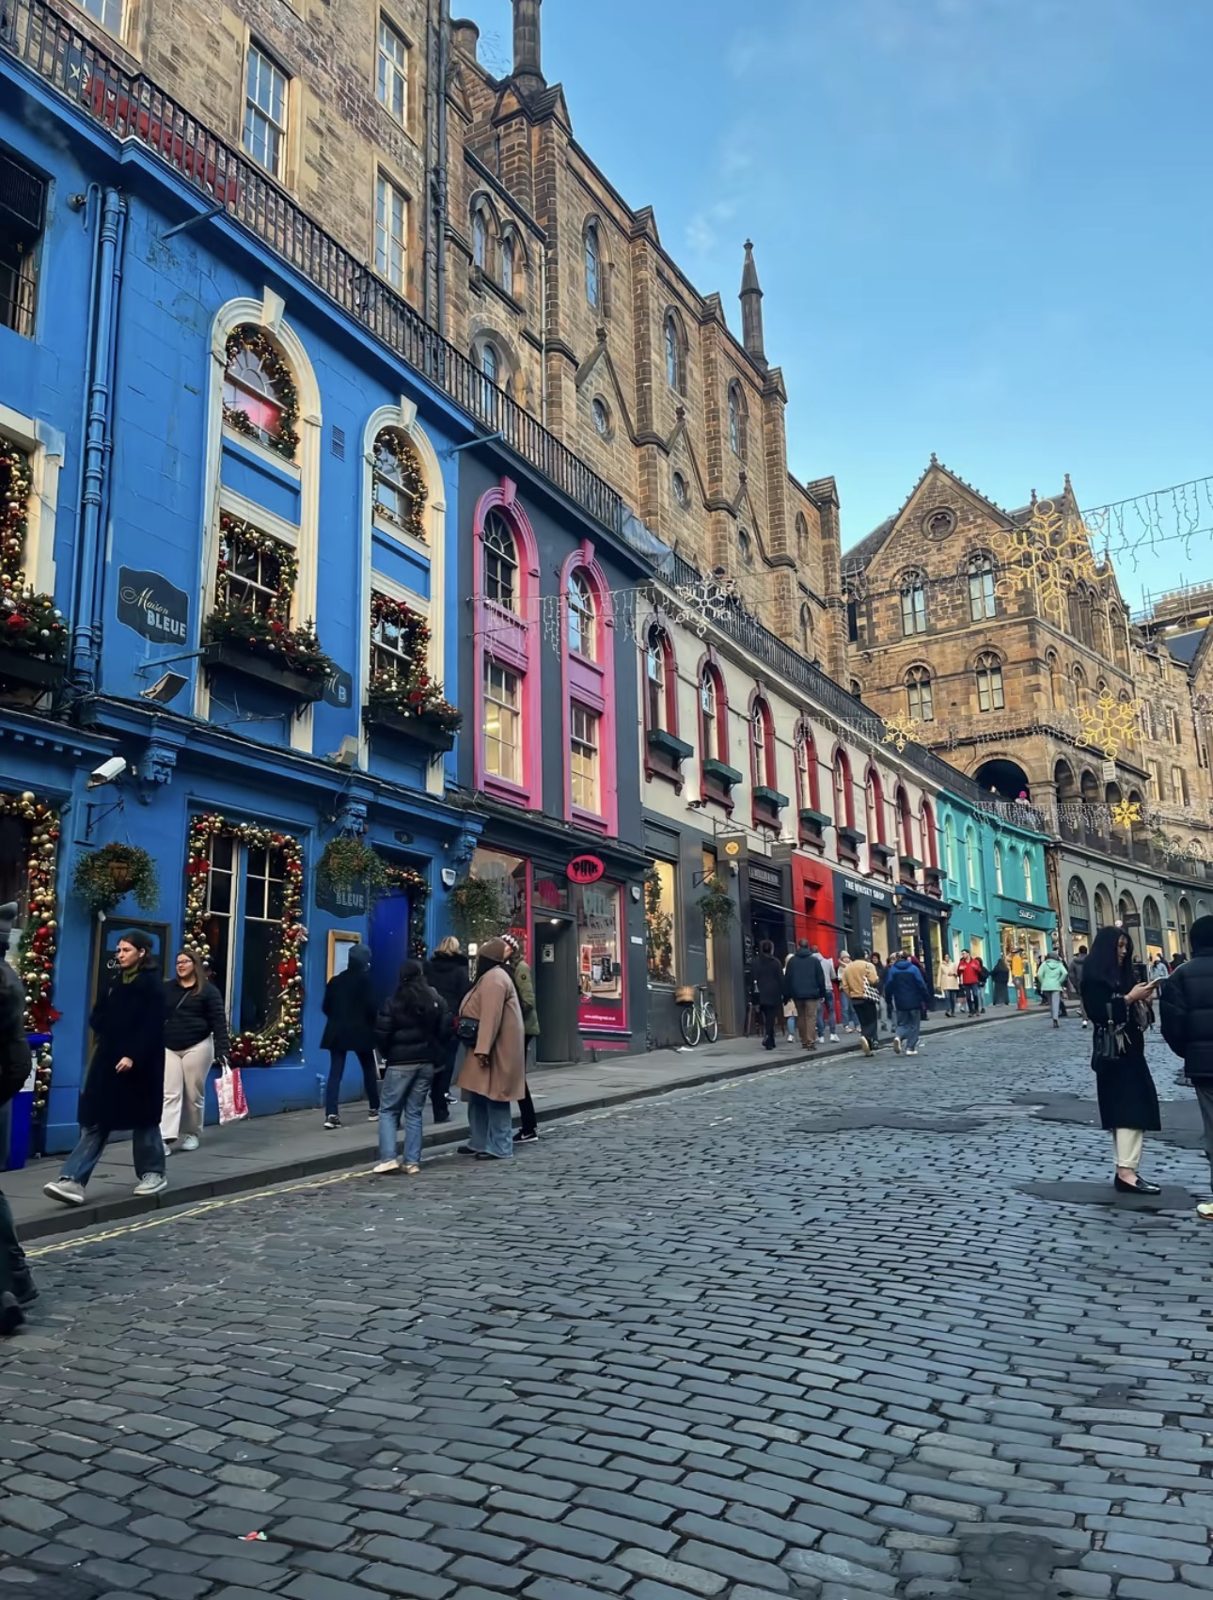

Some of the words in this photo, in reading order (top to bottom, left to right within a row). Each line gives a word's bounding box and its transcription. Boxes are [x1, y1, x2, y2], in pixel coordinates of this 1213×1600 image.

[120, 586, 169, 615] Maison
[147, 609, 187, 638] BLEUE
[844, 879, 855, 890] THE
[854, 882, 872, 897] WHISKY
[872, 889, 885, 901] SHOP
